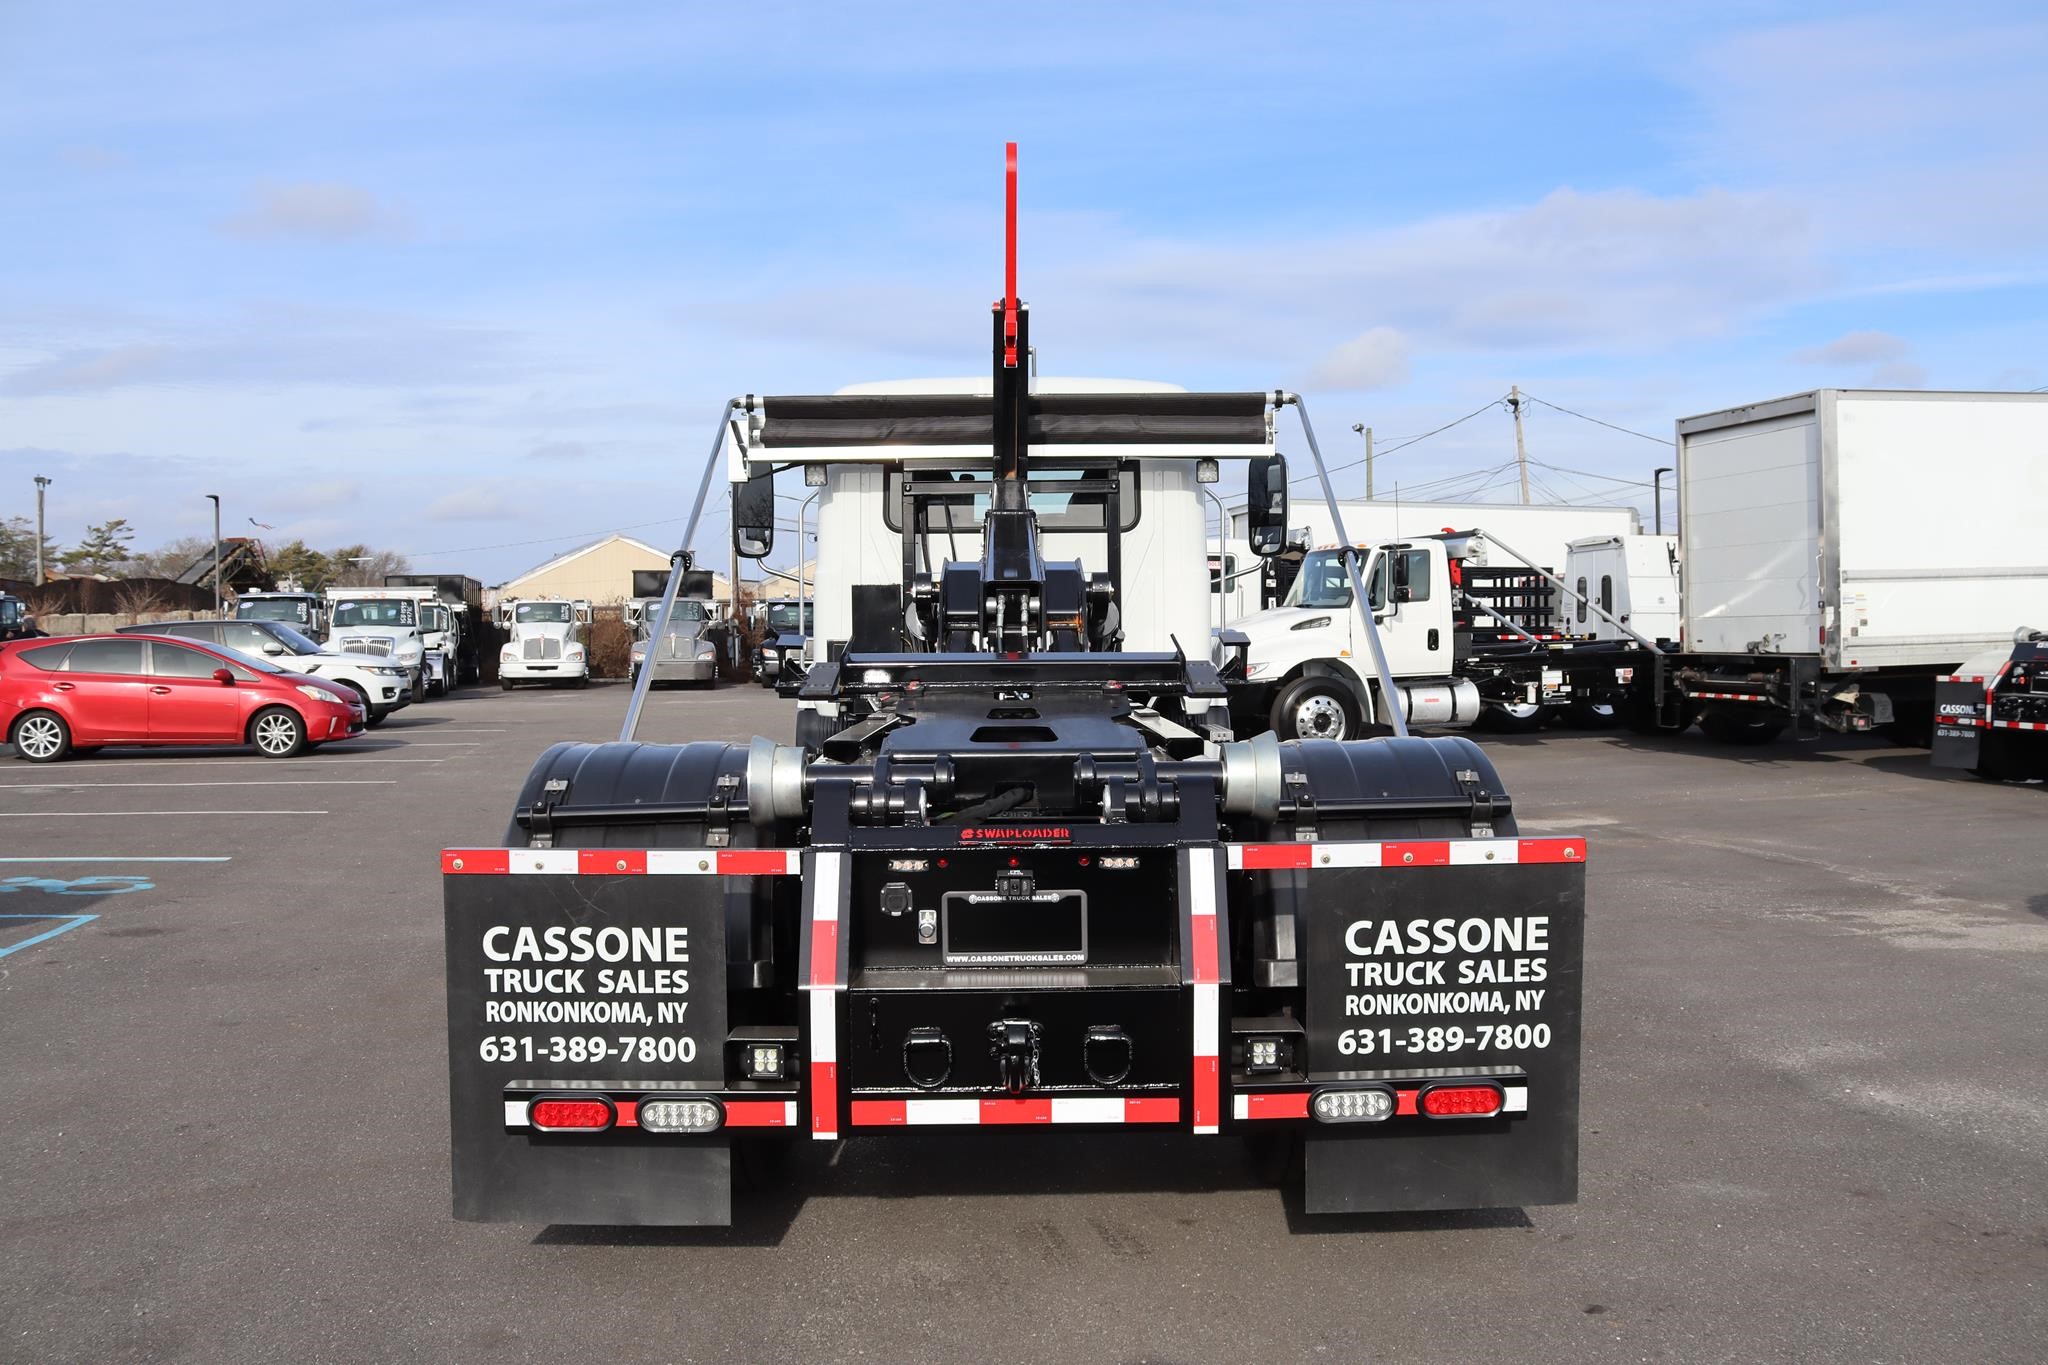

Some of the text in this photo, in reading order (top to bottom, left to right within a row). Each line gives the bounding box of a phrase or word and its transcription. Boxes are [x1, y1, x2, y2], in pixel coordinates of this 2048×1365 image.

[1937, 729, 1976, 738] 631-389-7800
[976, 828, 1070, 839] SWAPLOADER
[482, 925, 690, 963] CASSONE
[1344, 916, 1549, 956] CASSONE
[946, 954, 1085, 963] WWW.CASSONETRUCKSALES.COM
[483, 968, 690, 994] TRUCK SALES
[1345, 958, 1547, 987] TRUCK SALES
[486, 1001, 688, 1027] RONKONKOMA, NY
[1345, 989, 1546, 1016] RONKONKOMA, NY
[479, 1035, 697, 1063] 631-389-7800
[1337, 1023, 1551, 1055] 631-389-7800
